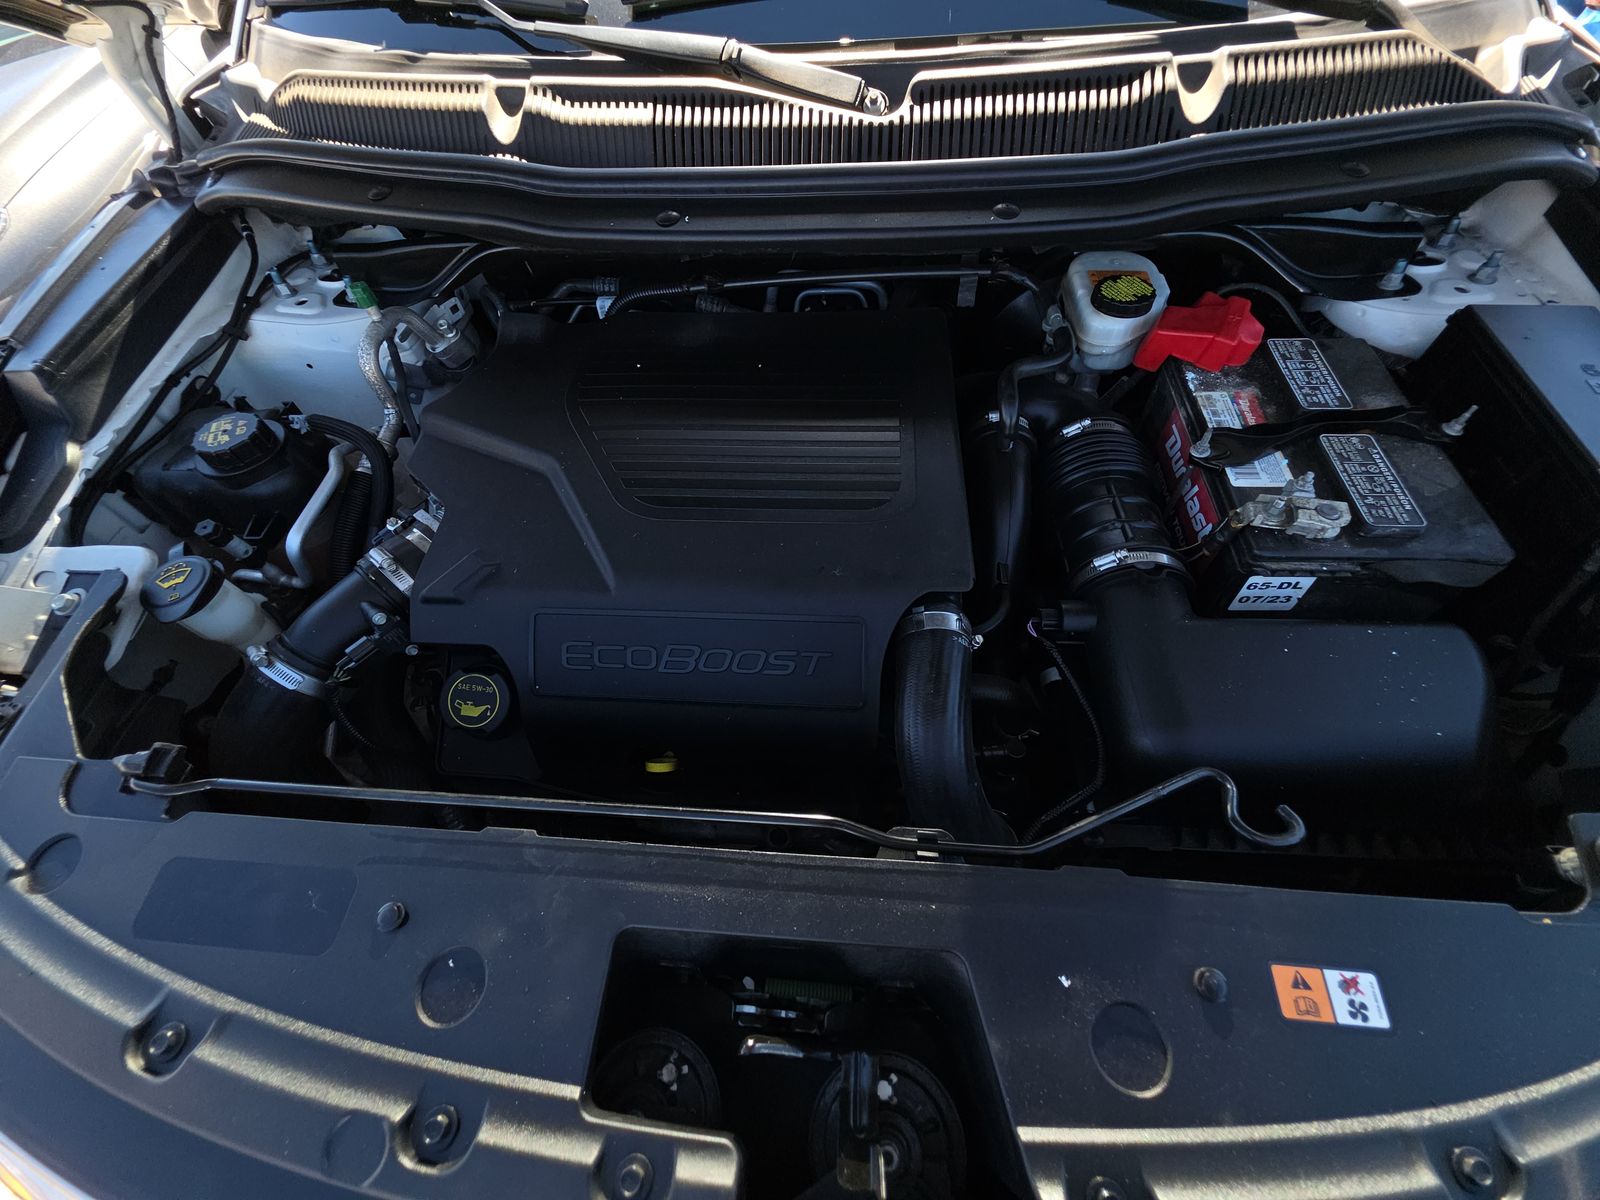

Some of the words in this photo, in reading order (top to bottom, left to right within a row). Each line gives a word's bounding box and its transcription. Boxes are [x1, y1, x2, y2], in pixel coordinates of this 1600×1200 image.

[1372, 453, 1413, 510] DANGER/POISON
[1245, 581, 1303, 591] 65-DL
[1237, 595, 1292, 605] 07/23
[457, 683, 471, 691] SAE
[471, 684, 494, 694] 5W-30
